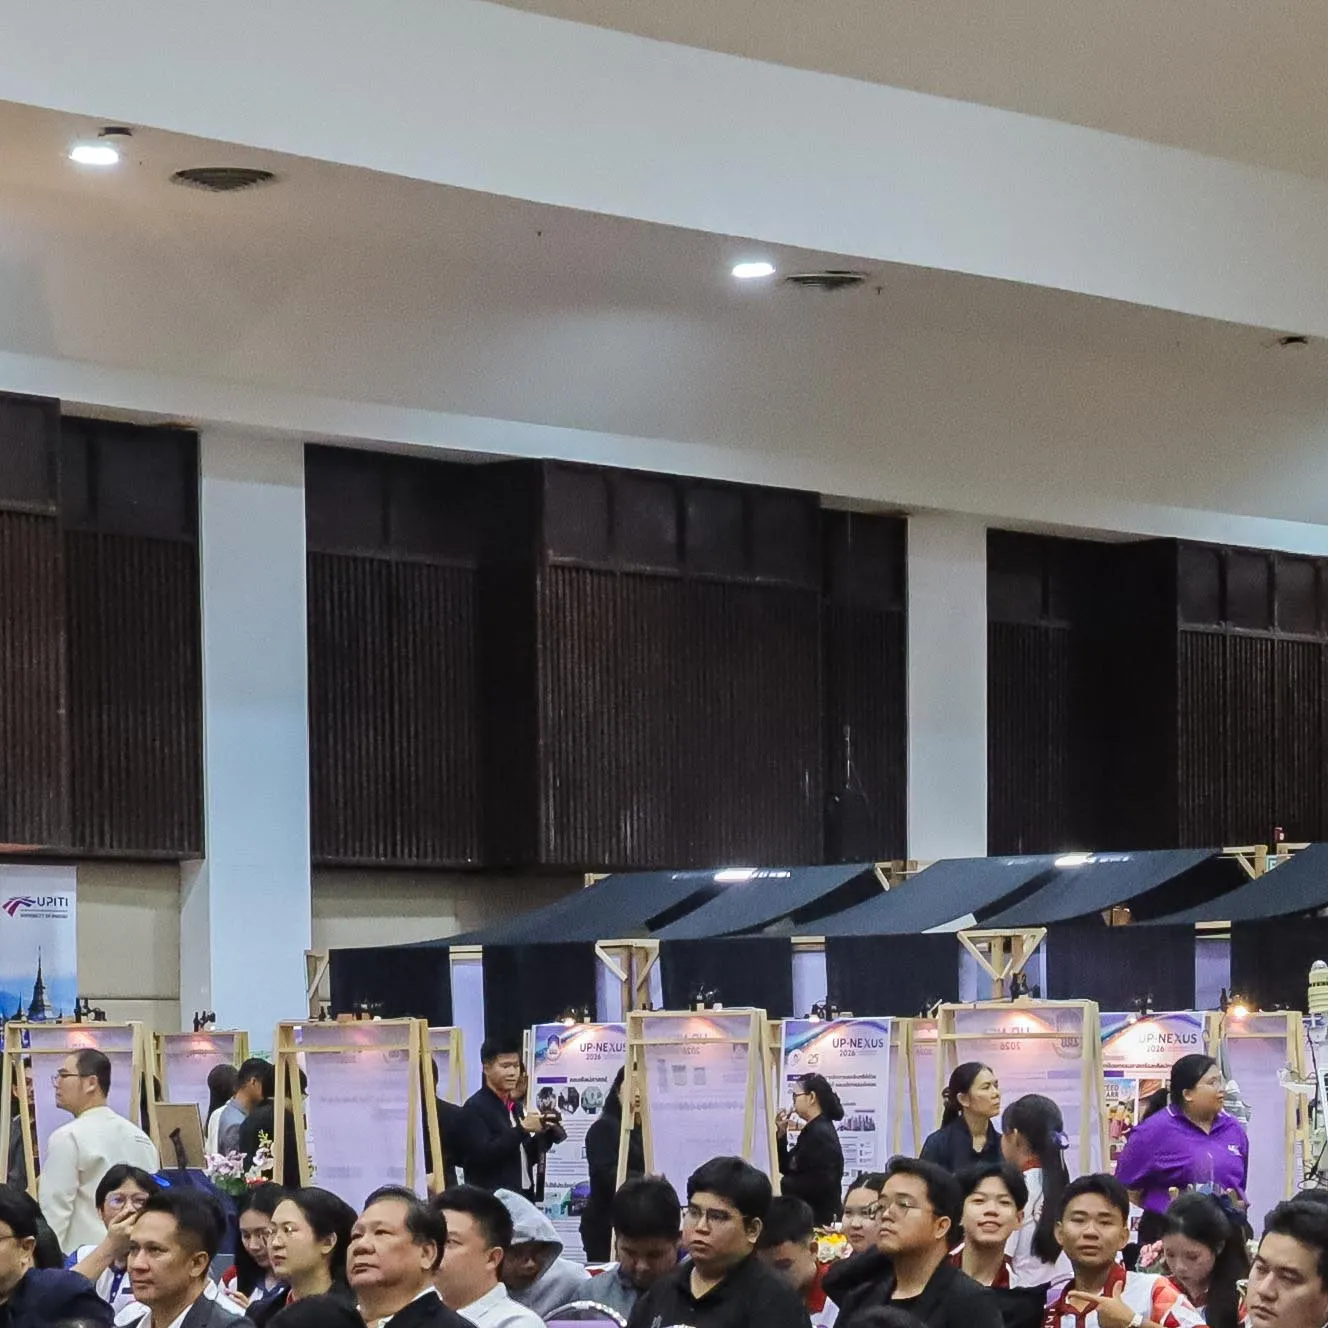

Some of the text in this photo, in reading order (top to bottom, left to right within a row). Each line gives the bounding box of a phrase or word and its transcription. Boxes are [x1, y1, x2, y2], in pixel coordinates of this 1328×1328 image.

[36, 896, 69, 907] UPITI
[832, 1038, 884, 1049] UP-NEXUS
[1139, 1033, 1198, 1044] UP-NEXUS
